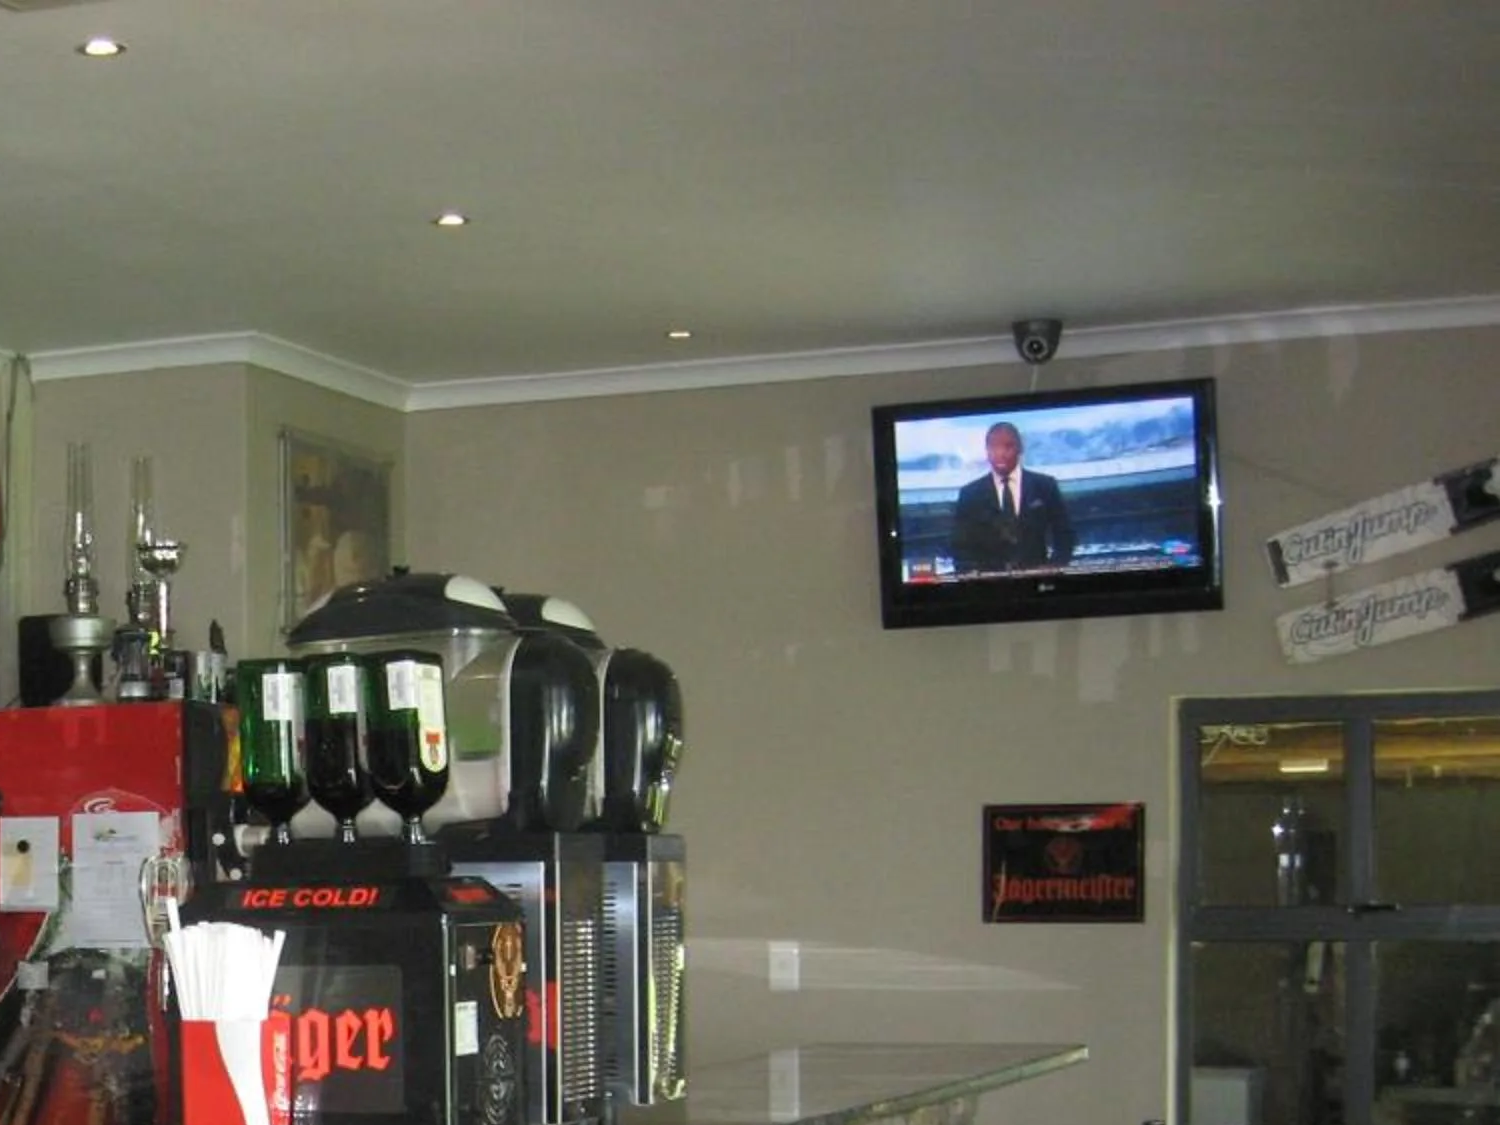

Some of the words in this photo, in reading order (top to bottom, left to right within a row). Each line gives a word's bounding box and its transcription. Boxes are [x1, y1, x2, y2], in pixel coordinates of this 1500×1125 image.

[243, 888, 285, 908] ICE
[292, 887, 379, 907] COLD!
[269, 994, 394, 1082] ger
